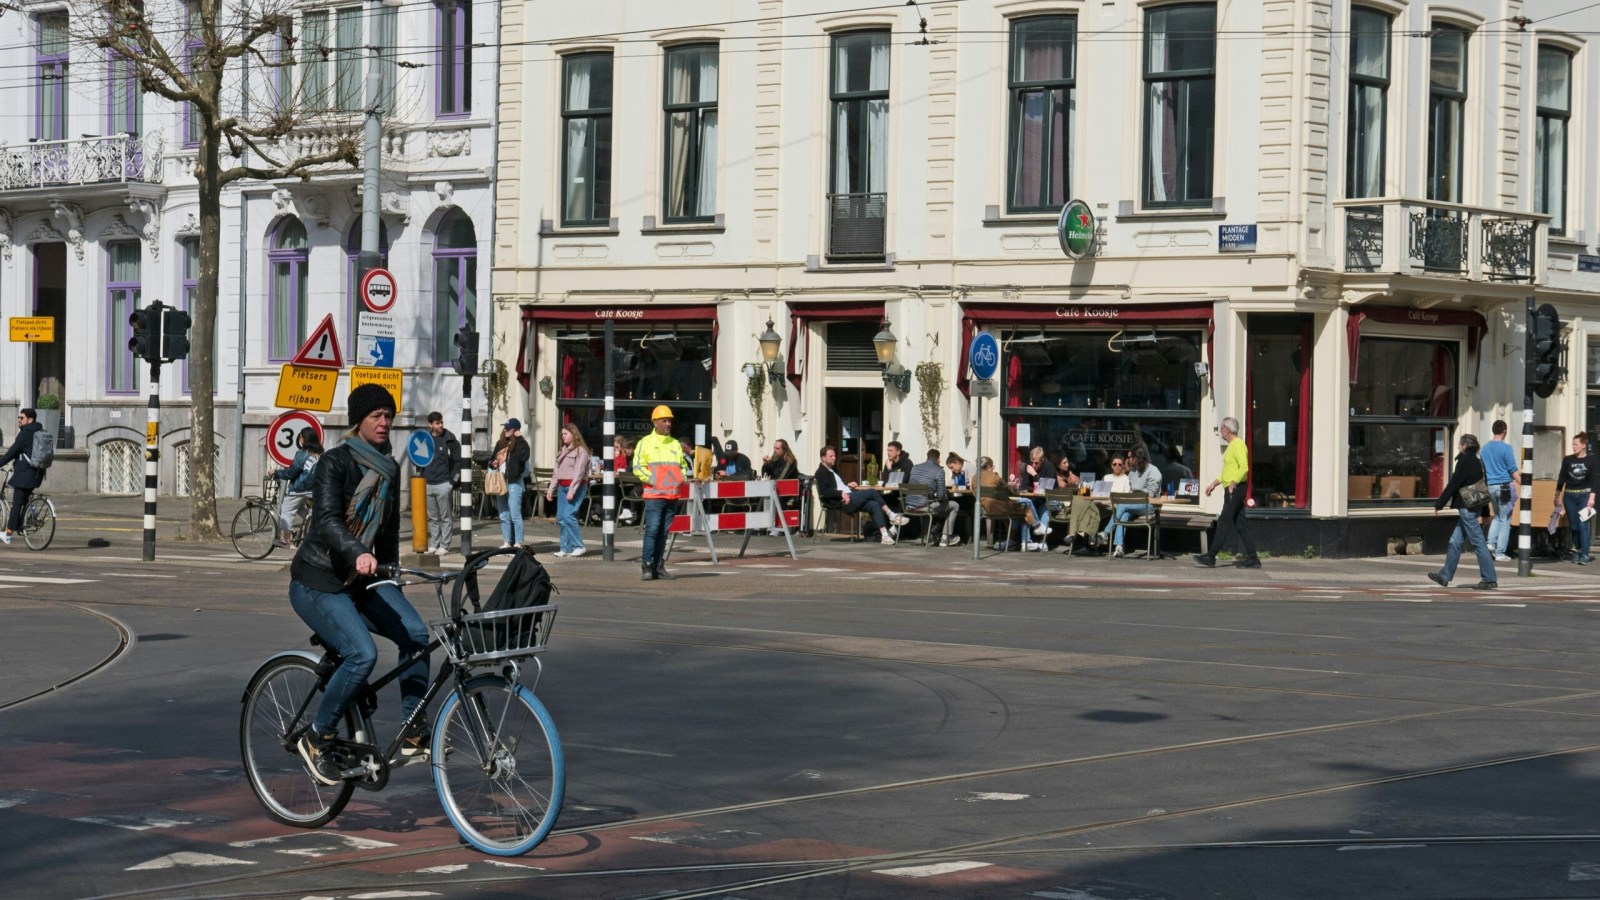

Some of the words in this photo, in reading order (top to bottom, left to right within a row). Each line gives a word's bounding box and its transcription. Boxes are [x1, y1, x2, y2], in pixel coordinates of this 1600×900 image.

[1222, 226, 1249, 234] PLANTAGE
[1222, 234, 1245, 242] MIDDEN
[615, 309, 643, 319] Koosje
[1055, 306, 1080, 317] Café
[1084, 306, 1119, 319] Koosje
[361, 315, 392, 323] uitgezonderd
[292, 369, 327, 381] Fietsers
[355, 370, 381, 380] Voetpad
[382, 372, 400, 380] dicht
[302, 384, 313, 392] op
[288, 394, 320, 405] rijbaan
[1098, 433, 1132, 443] KOOSJE
